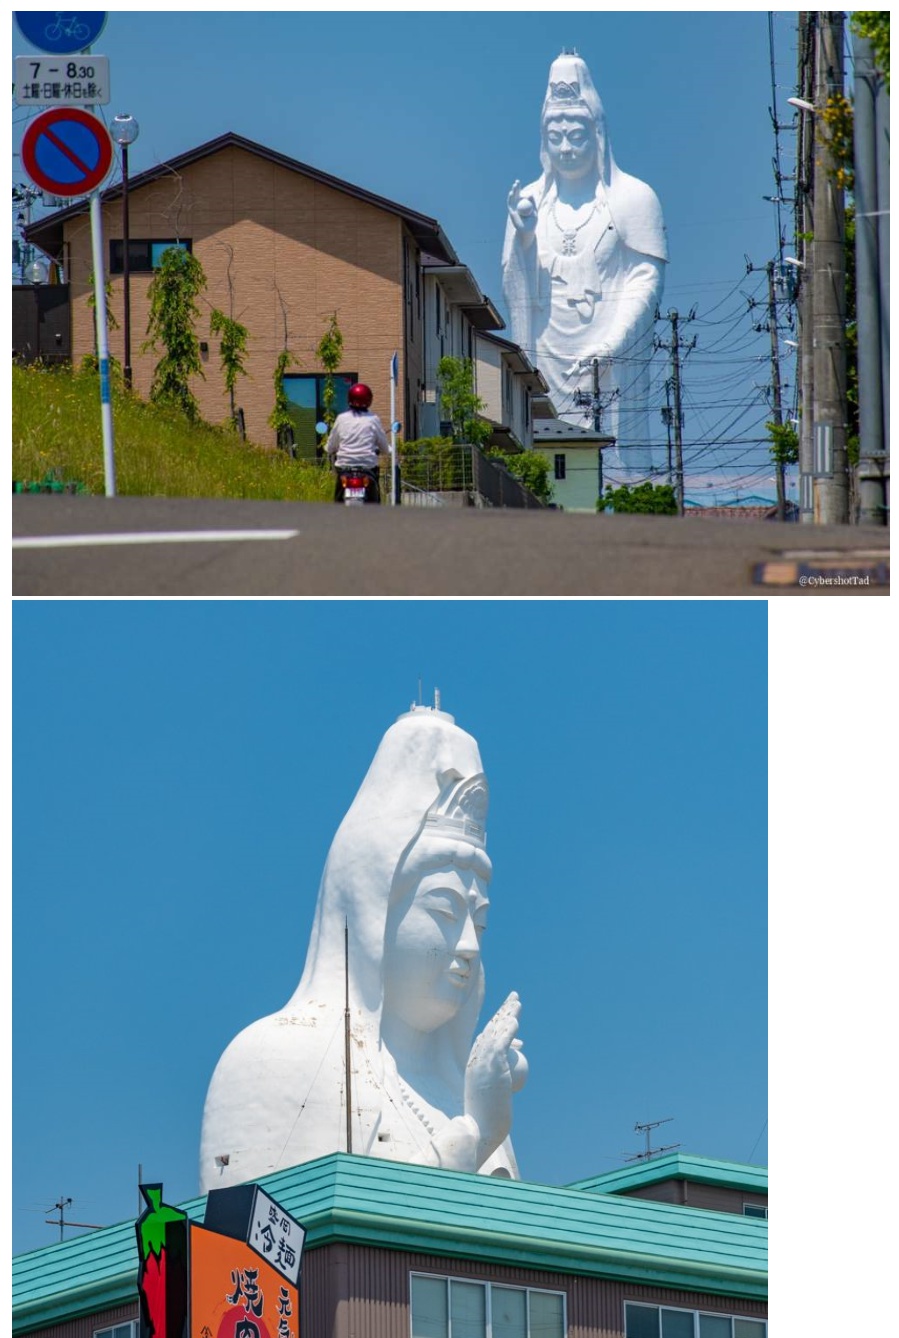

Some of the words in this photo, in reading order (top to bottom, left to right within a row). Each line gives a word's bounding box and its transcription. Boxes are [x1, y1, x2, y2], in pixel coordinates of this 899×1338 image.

[29, 62, 41, 79] 7
[268, 1204, 291, 1237] 盛岡
[255, 1220, 296, 1271] 冷麺
